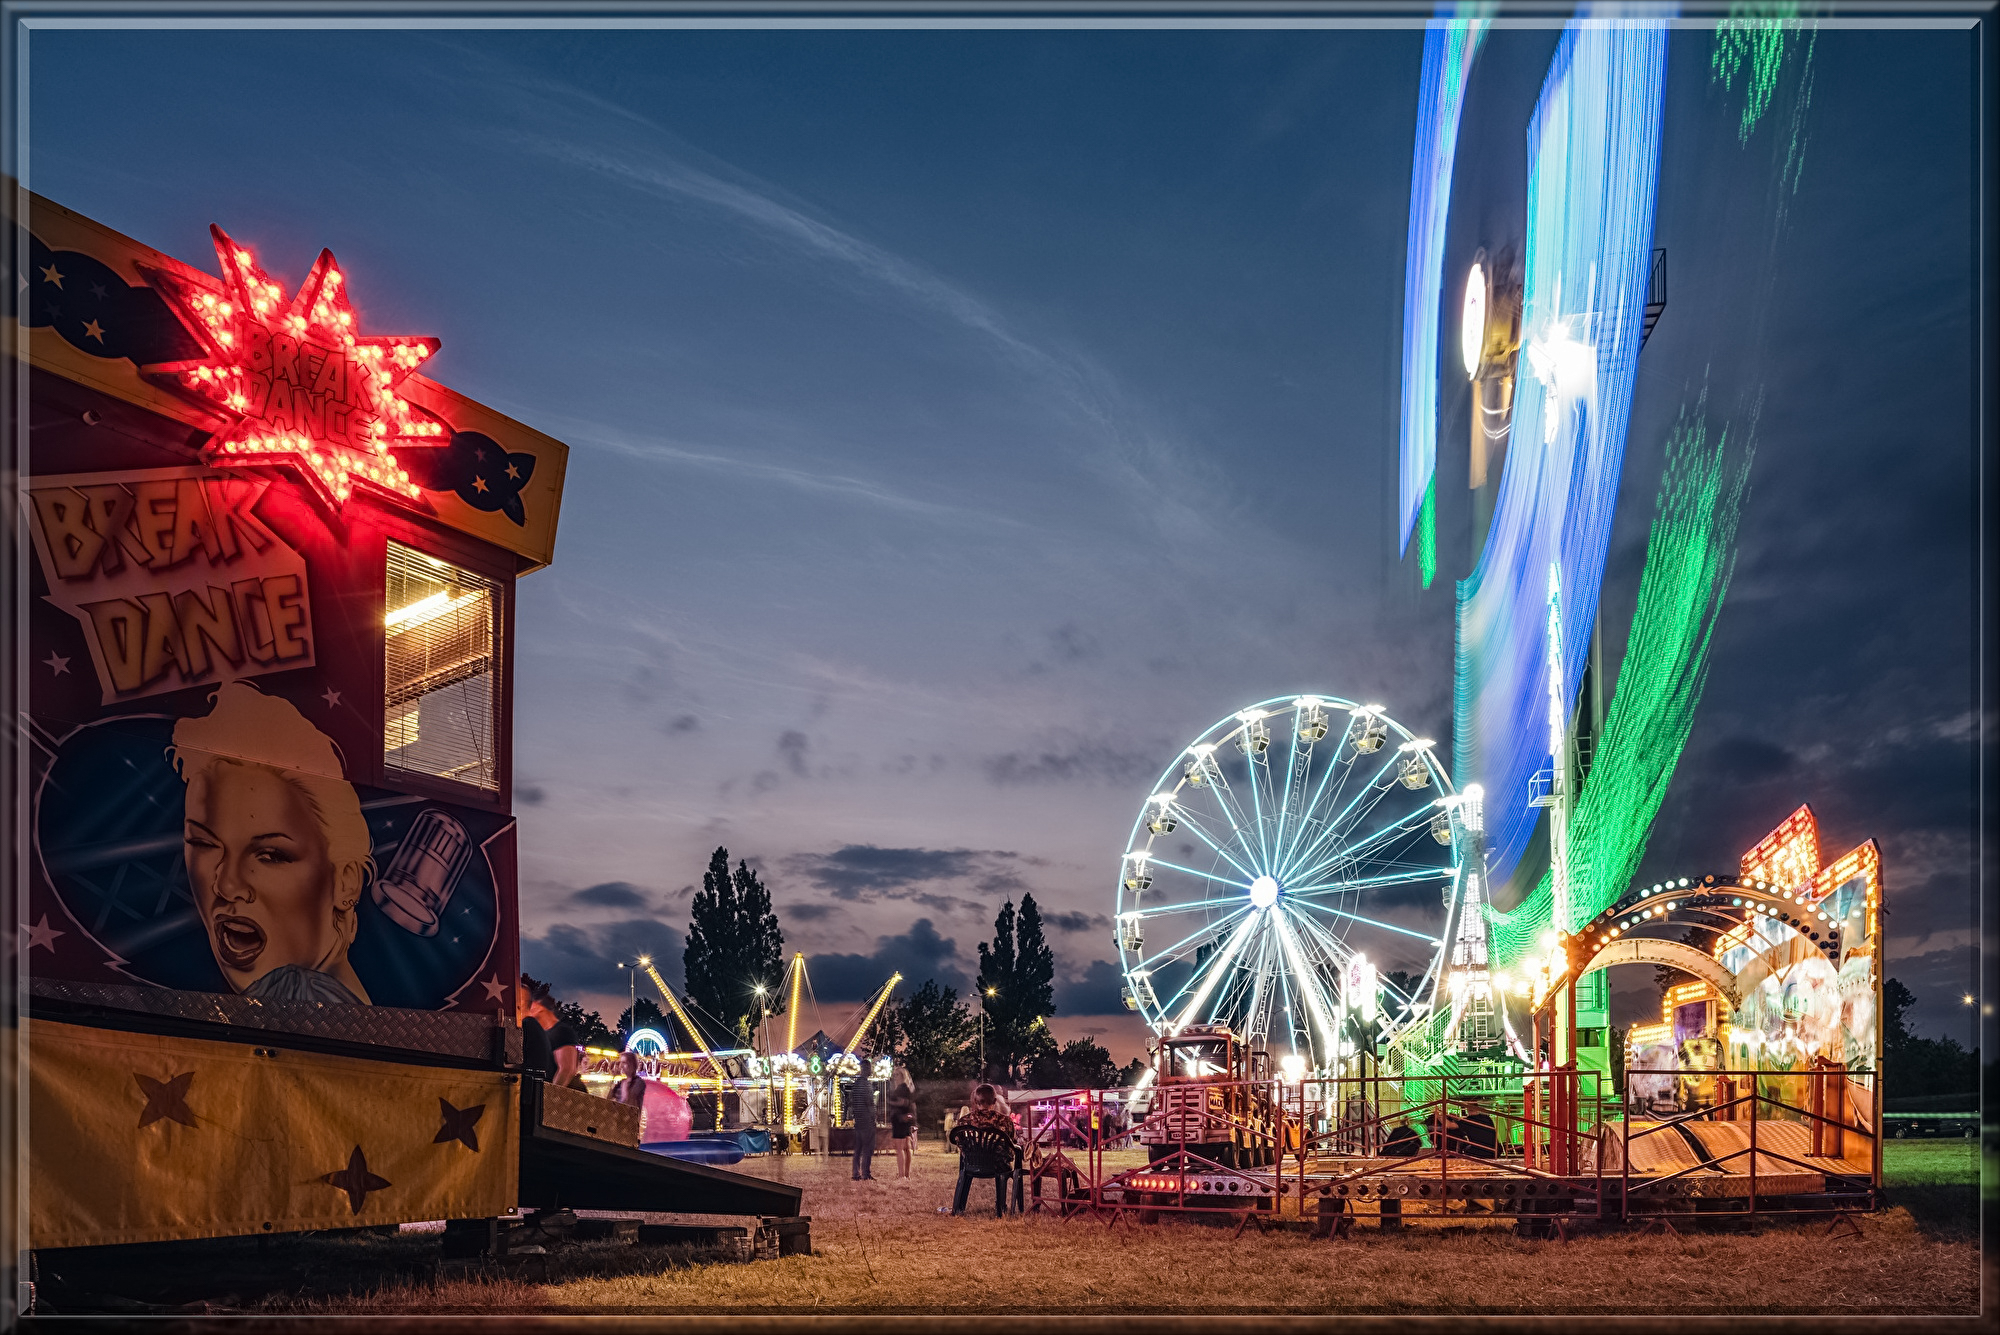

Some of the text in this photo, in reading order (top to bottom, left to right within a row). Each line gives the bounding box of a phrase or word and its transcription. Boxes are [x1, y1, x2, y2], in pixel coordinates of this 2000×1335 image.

[240, 367, 380, 457] DANCE
[243, 319, 372, 413] BREAK
[30, 477, 273, 580] BREAK
[76, 574, 309, 694] DANCE
